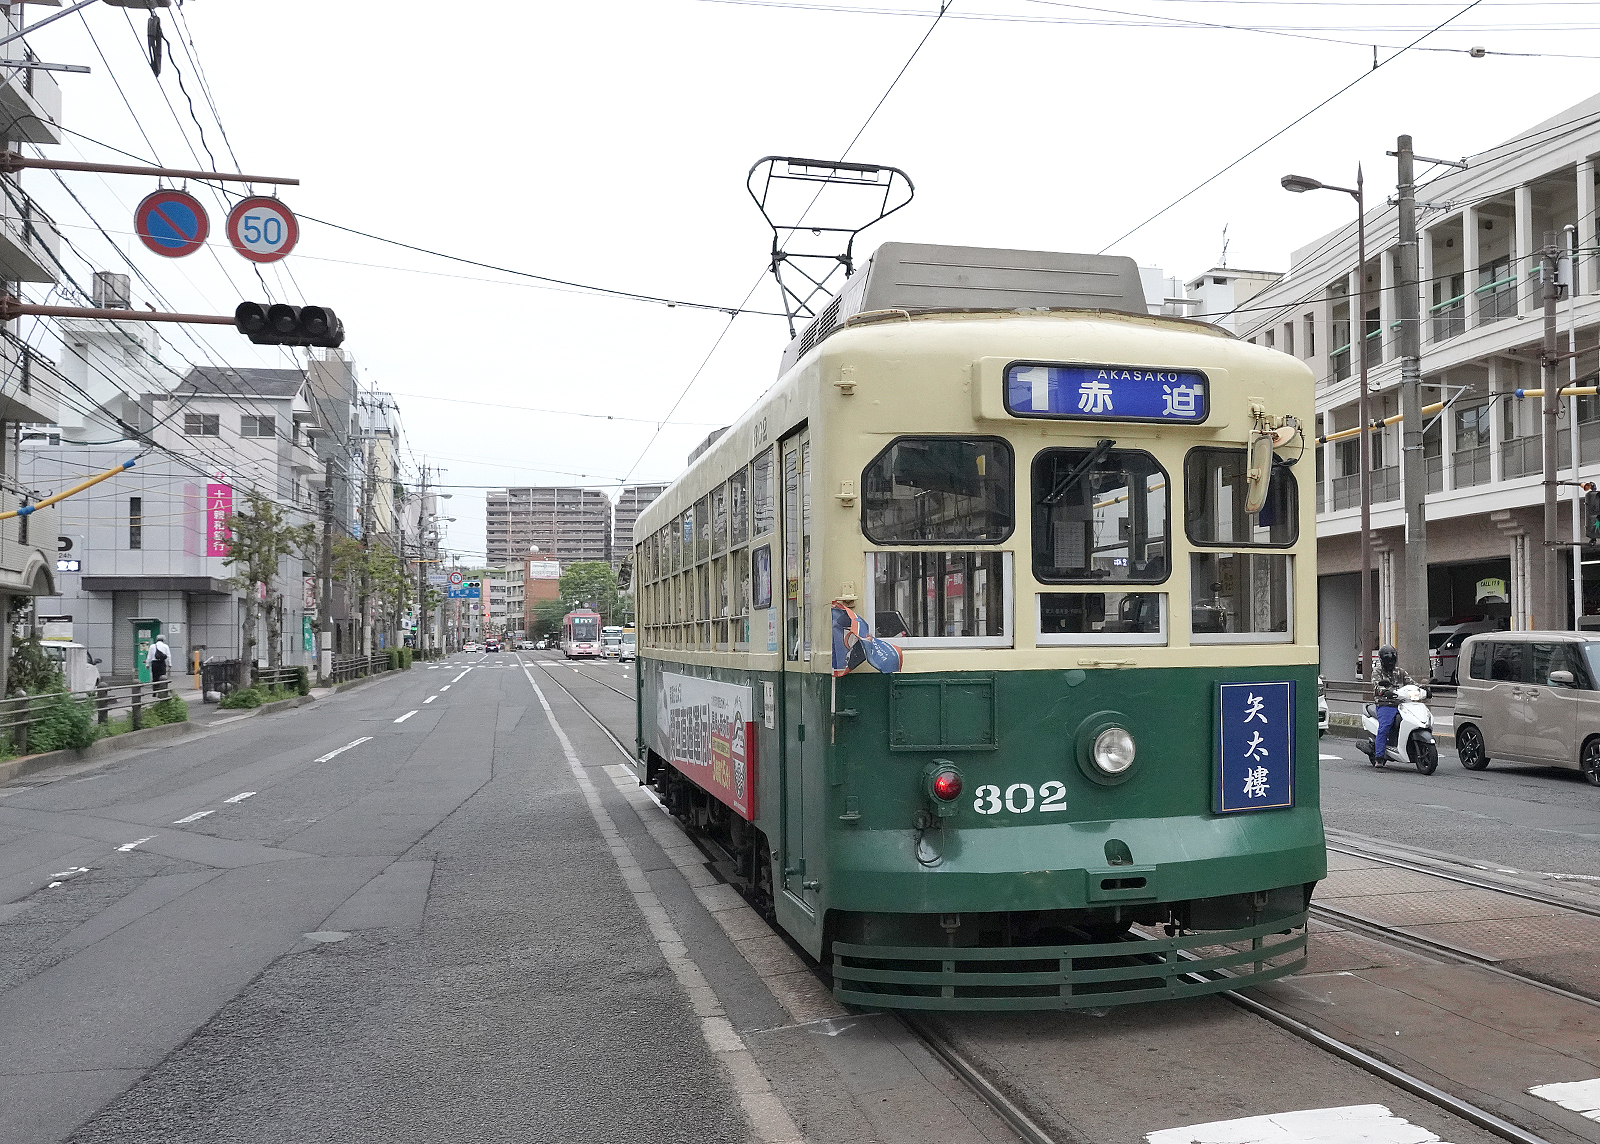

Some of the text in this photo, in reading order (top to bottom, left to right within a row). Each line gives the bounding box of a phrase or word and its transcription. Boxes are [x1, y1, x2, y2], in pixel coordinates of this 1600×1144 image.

[244, 216, 281, 245] 50
[1016, 366, 1049, 411] 1
[1097, 369, 1178, 383] AKASAKO
[1078, 380, 1196, 417] 赤迫
[753, 416, 768, 449] 302
[213, 489, 226, 552] 十八親和銀行
[1243, 691, 1271, 799] 矢太樓
[973, 780, 1067, 815] 302
